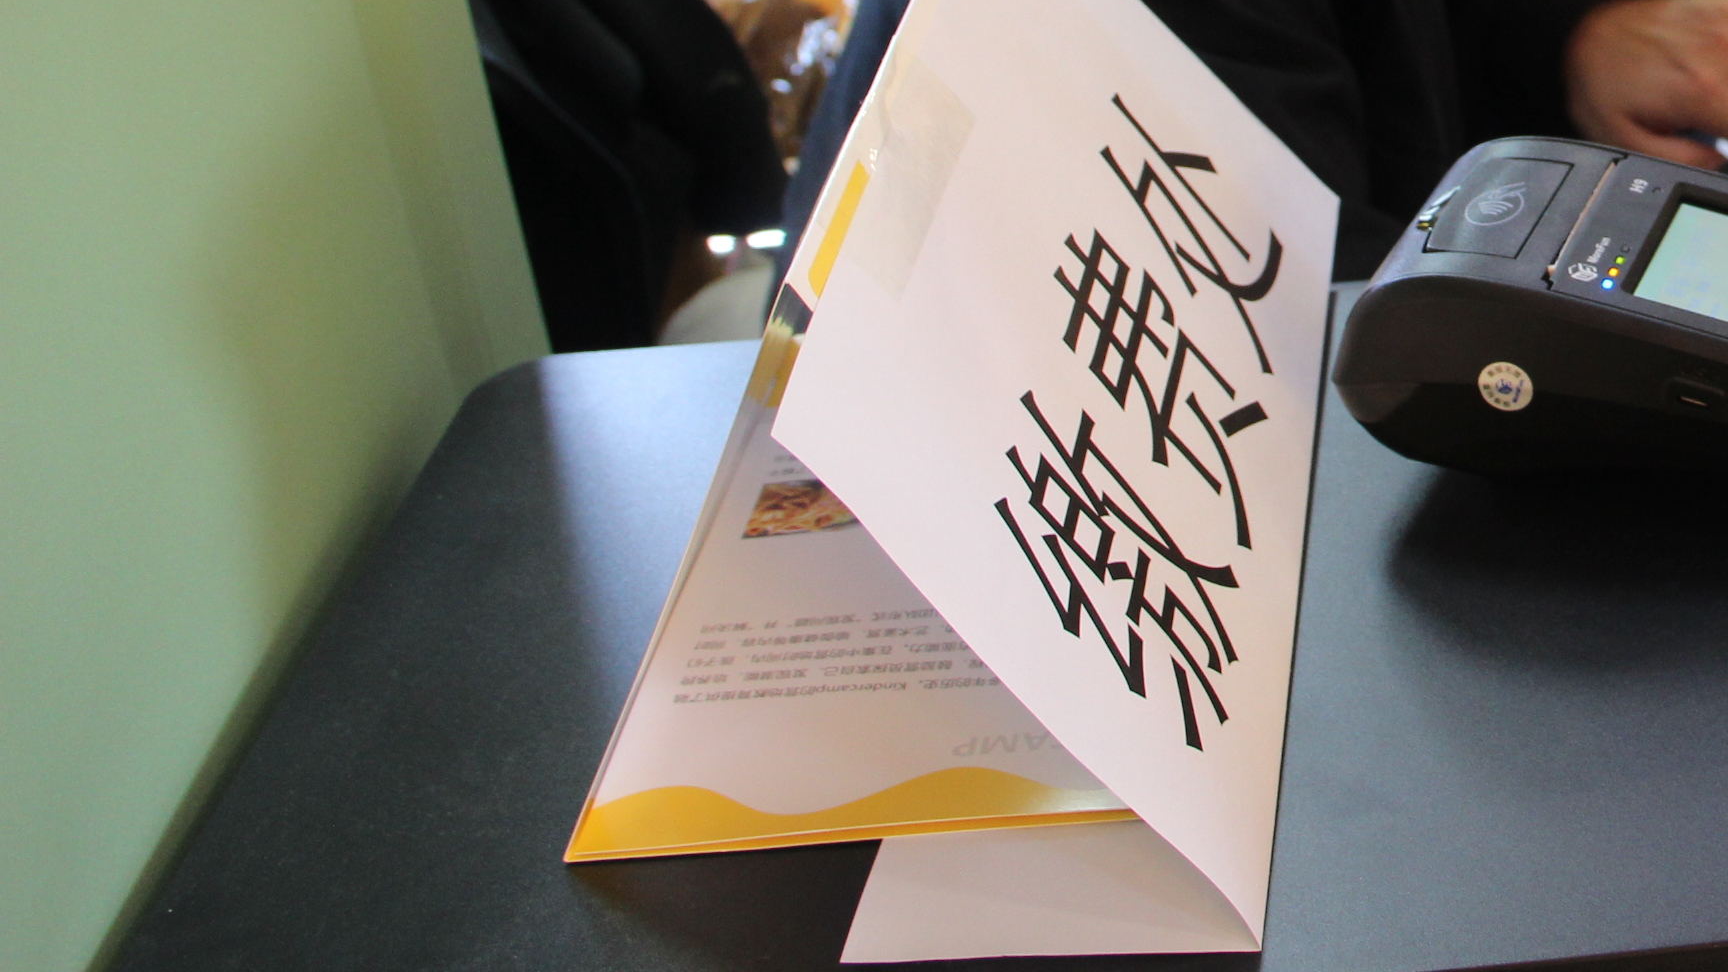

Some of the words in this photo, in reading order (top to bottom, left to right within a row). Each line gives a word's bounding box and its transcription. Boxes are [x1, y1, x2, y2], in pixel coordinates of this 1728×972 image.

[994, 92, 1283, 754] 缴费处
[951, 731, 1058, 757] AMP
